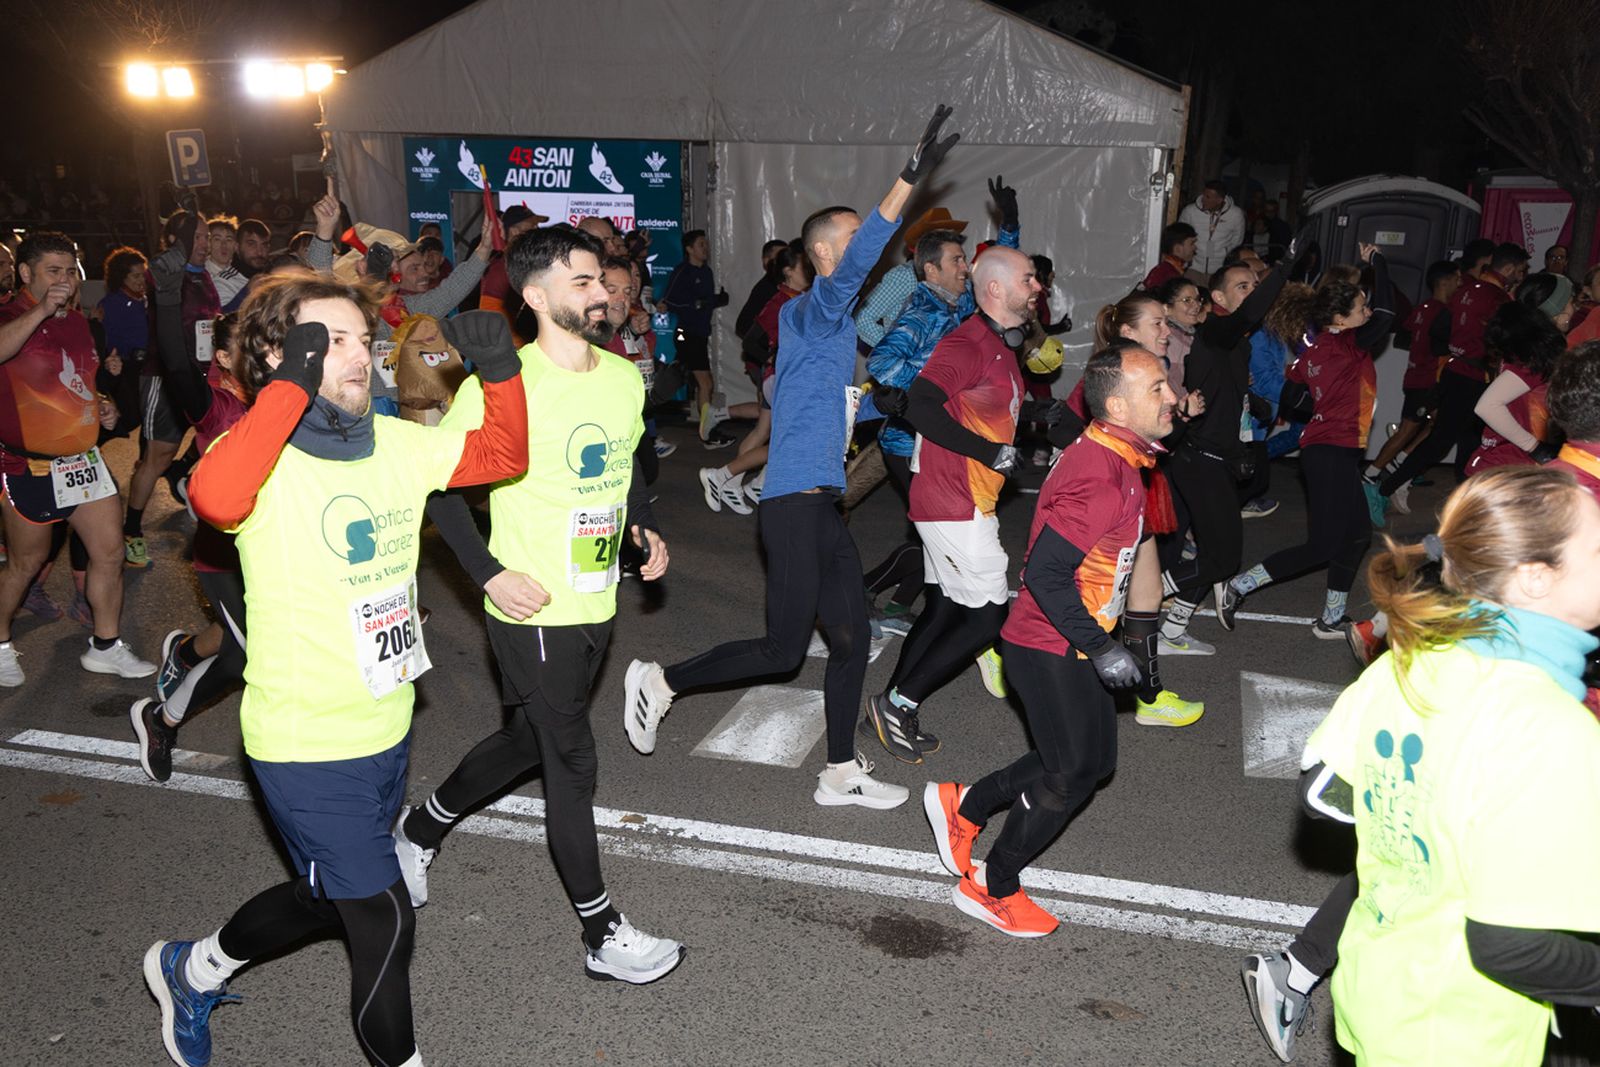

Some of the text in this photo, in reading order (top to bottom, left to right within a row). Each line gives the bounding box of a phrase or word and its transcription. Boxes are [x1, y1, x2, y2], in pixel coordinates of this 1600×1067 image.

[176, 136, 199, 180] P
[467, 167, 480, 182] 43
[504, 164, 571, 188] ANTÓN
[599, 171, 613, 185] 43
[637, 218, 678, 228] calderón
[70, 378, 84, 394] 43
[65, 466, 98, 488] 3531
[577, 527, 595, 537] SAN
[374, 597, 398, 616] NOCHE
[398, 595, 407, 606] DE
[365, 617, 385, 633] SAN
